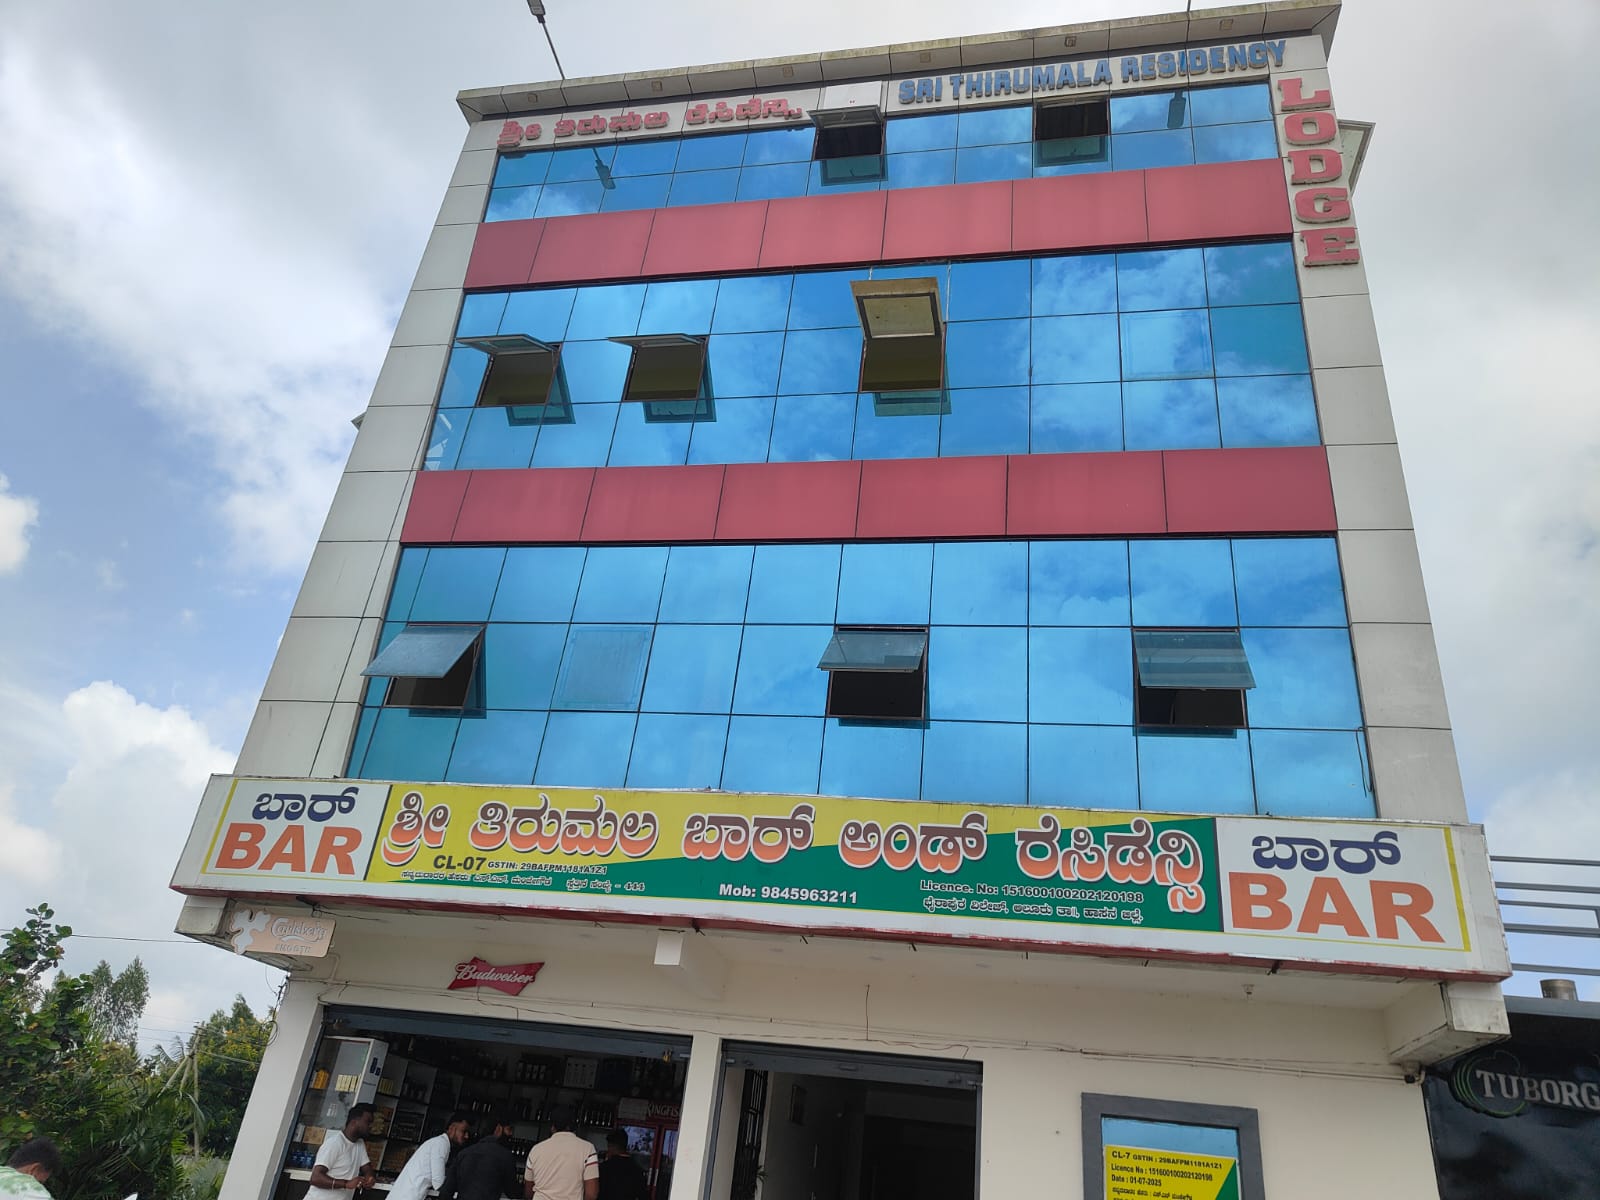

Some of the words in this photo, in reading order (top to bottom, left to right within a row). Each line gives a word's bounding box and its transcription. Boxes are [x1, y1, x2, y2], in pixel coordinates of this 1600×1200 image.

[898, 78, 942, 105] SRI
[949, 58, 1113, 100] THIRUMALA
[1121, 40, 1290, 83] RESIDENCY
[497, 120, 542, 149] ಶ್ರೀ
[1277, 77, 1361, 267] LODGE
[251, 786, 359, 822] ಬಾರ್
[214, 821, 363, 876] BAR
[380, 791, 450, 867] ಶ್ರೀ
[468, 793, 660, 858] ತಿರುಮಲ
[681, 802, 817, 864] ಬಾರ್
[838, 811, 988, 874] ಅಂಡ್
[1014, 813, 1207, 913] ರೆಸಿಡೆನ್ಸಿ
[432, 854, 487, 871] CL-07
[487, 860, 519, 870] GSTIN:
[1251, 831, 1402, 875] ಬಾರ್
[718, 883, 756, 898] Mob:
[761, 885, 858, 905] 9845963211
[919, 880, 974, 893] Licence.
[976, 883, 999, 895] No:
[1001, 885, 1144, 903] 151600100202120198
[1228, 871, 1446, 944] BAR
[271, 917, 328, 942] Carlsberg
[455, 964, 535, 984] Budweiser
[1475, 1069, 1600, 1111] TUBORG
[1111, 1150, 1131, 1160] CL-7
